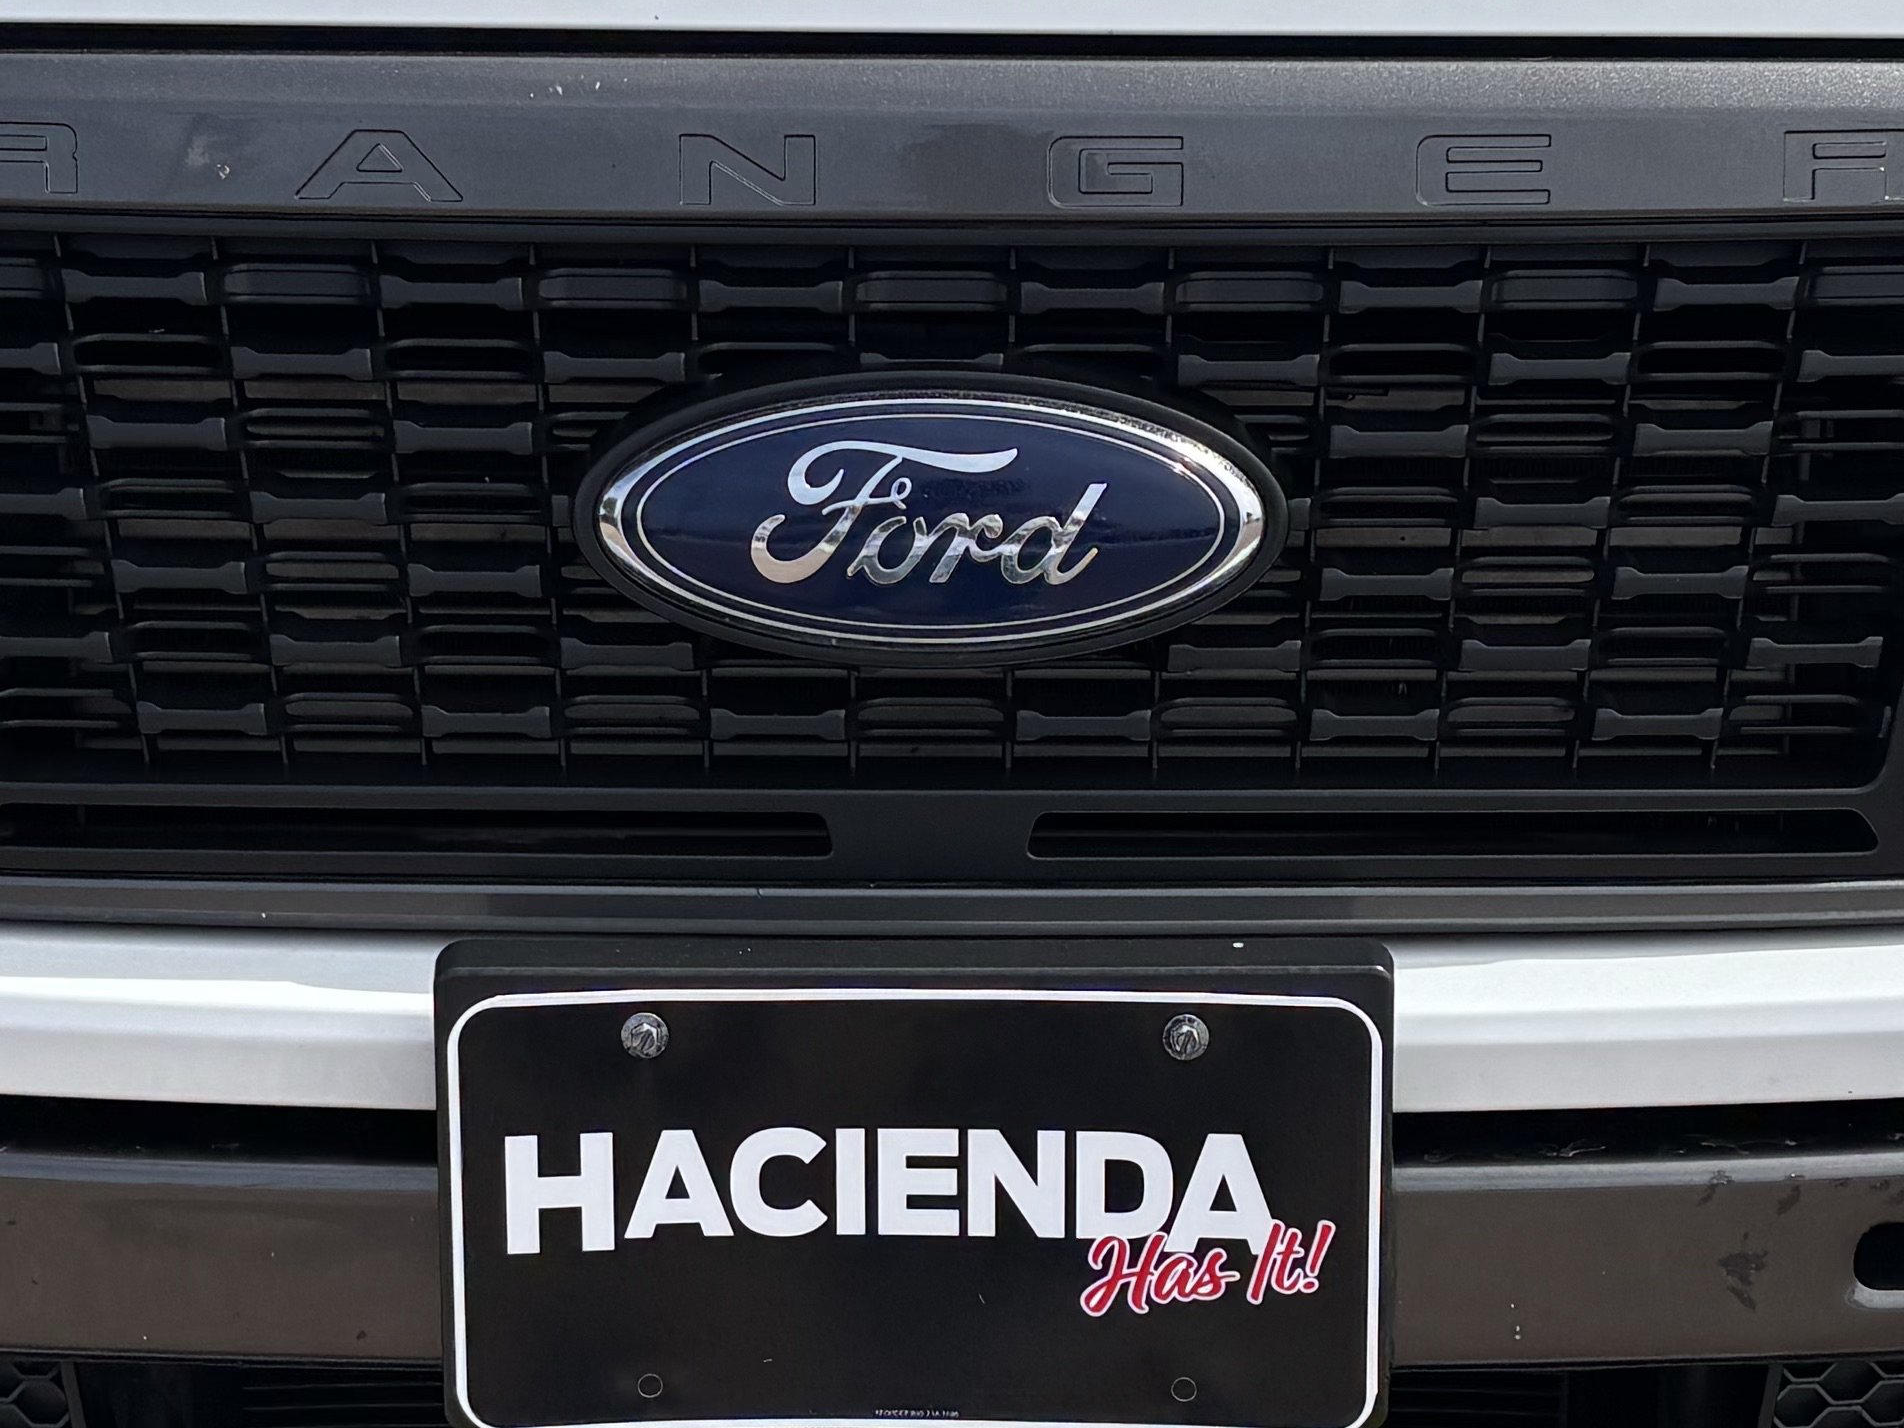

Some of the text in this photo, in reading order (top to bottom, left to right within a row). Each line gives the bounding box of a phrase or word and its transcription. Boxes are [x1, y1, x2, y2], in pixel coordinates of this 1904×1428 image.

[751, 440, 1107, 586] Ford
[504, 1125, 1273, 1255] HACIENDA
[1080, 1219, 1336, 1317] Has It!
